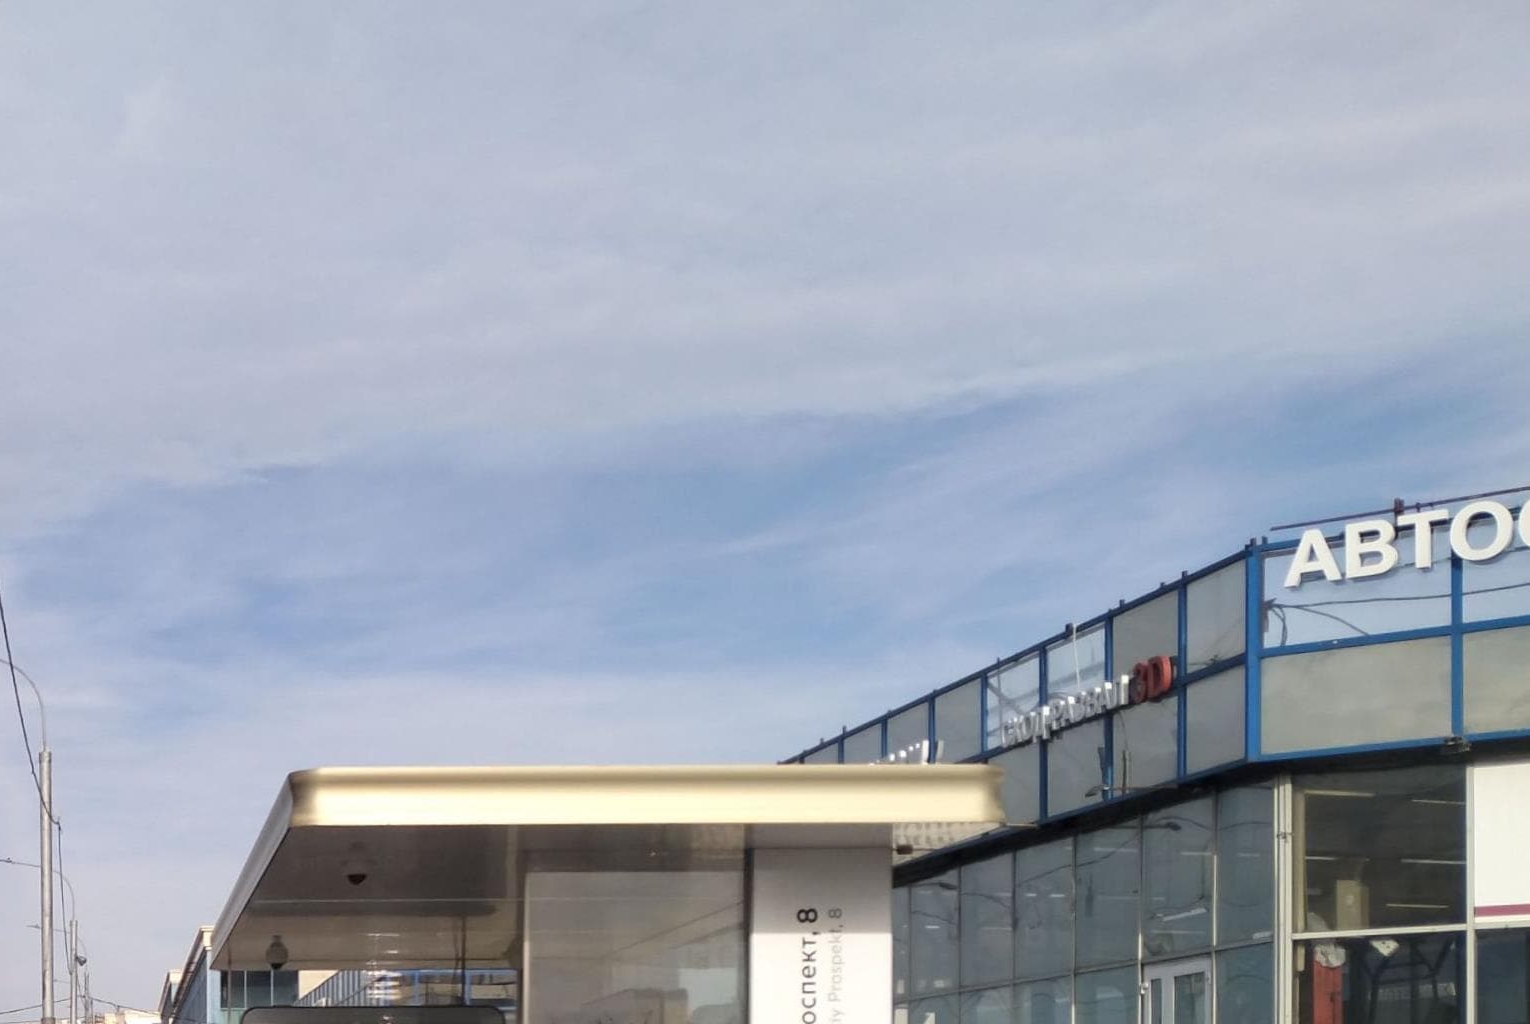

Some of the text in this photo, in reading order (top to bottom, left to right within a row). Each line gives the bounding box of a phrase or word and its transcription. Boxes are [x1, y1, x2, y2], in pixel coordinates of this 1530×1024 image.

[1283, 500, 1530, 589] АВТО
[1132, 655, 1175, 704] 3D
[797, 908, 818, 923] 8
[828, 908, 843, 919] 8
